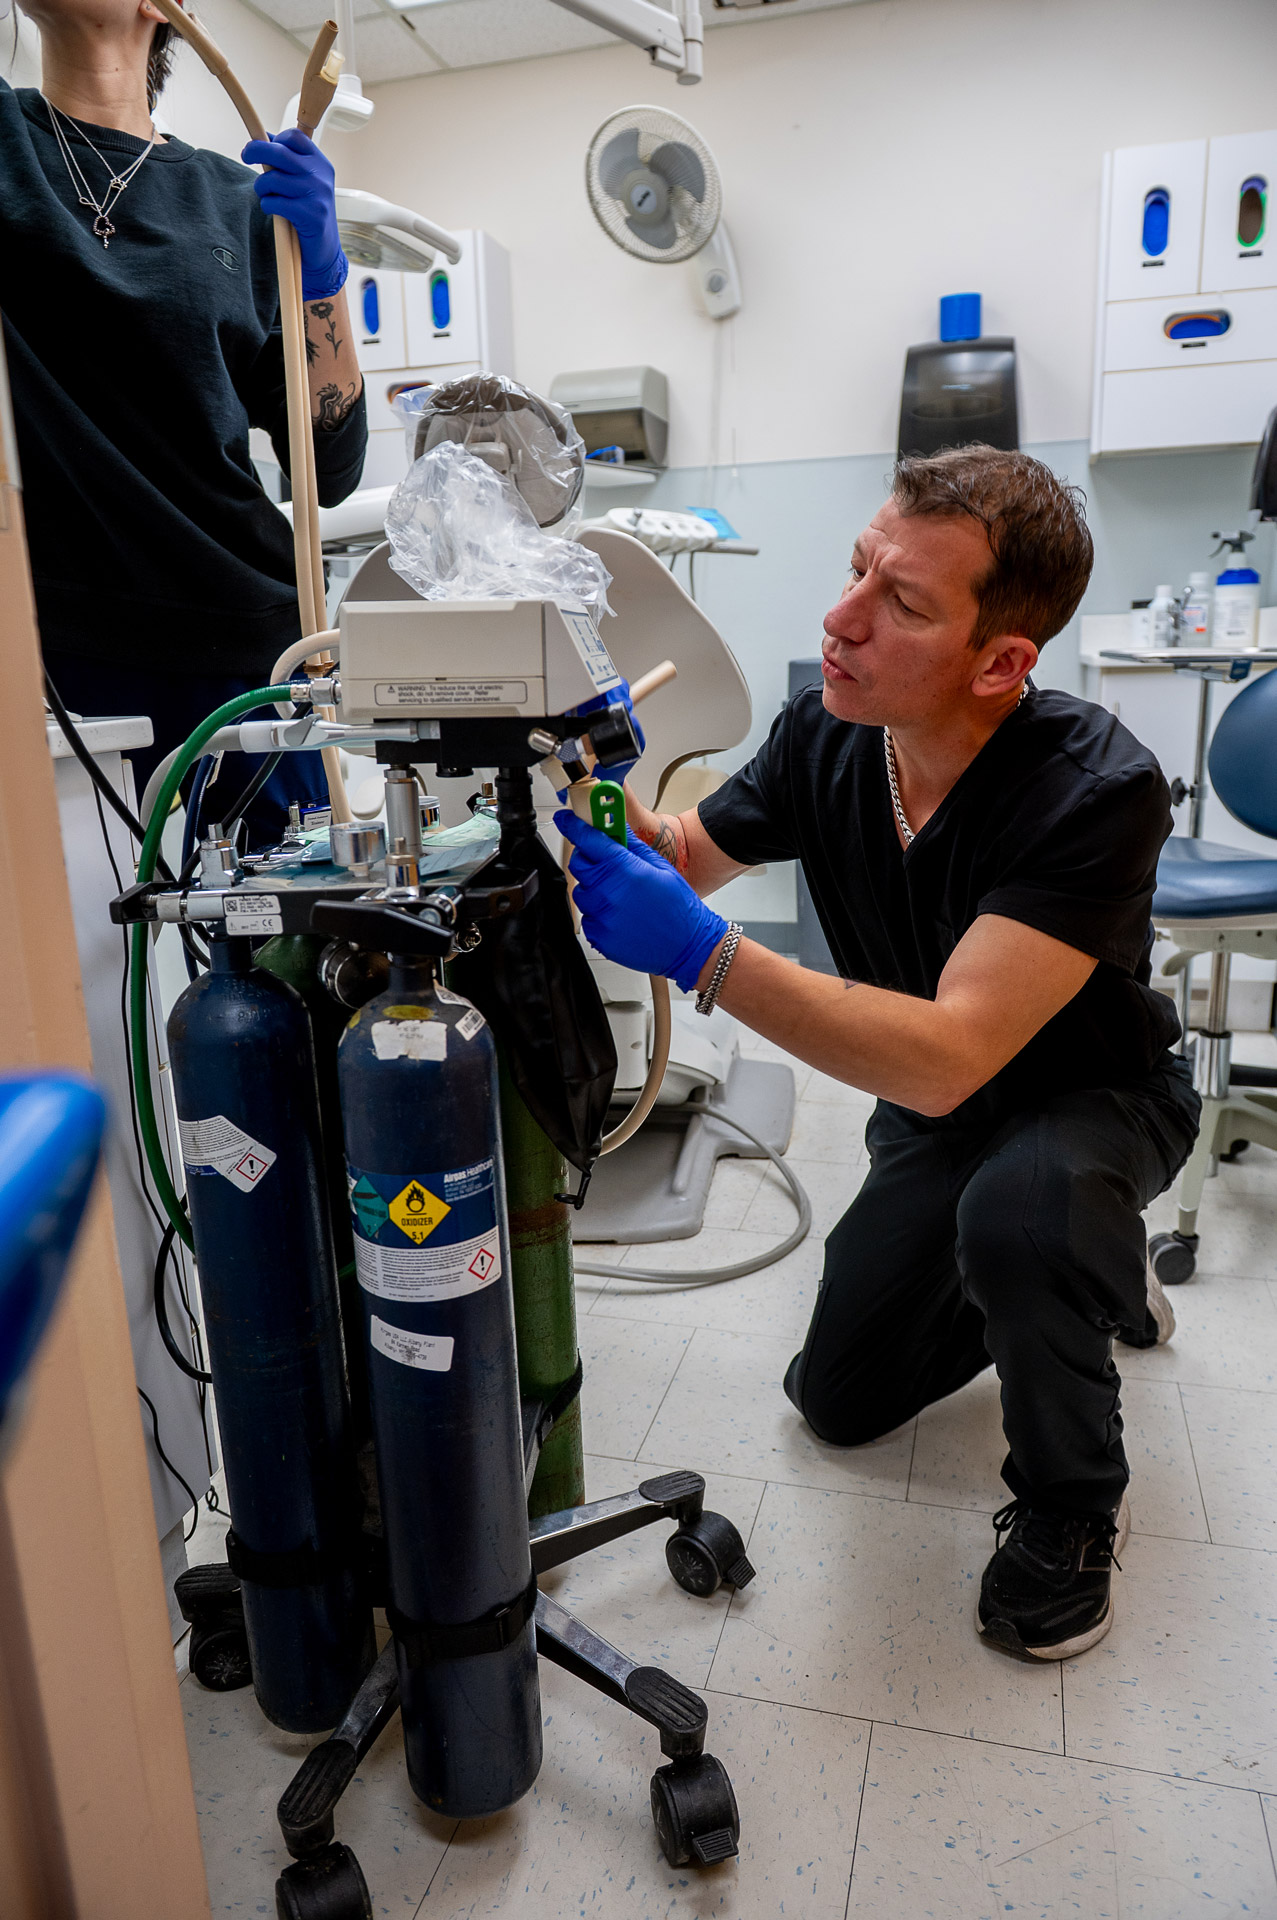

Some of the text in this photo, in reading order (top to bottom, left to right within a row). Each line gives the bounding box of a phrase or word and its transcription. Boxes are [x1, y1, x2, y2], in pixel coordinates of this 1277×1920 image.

[443, 1170, 467, 1183] Airgas
[401, 1217, 433, 1227] OXIDIZER
[411, 1231, 424, 1240] 5.1
